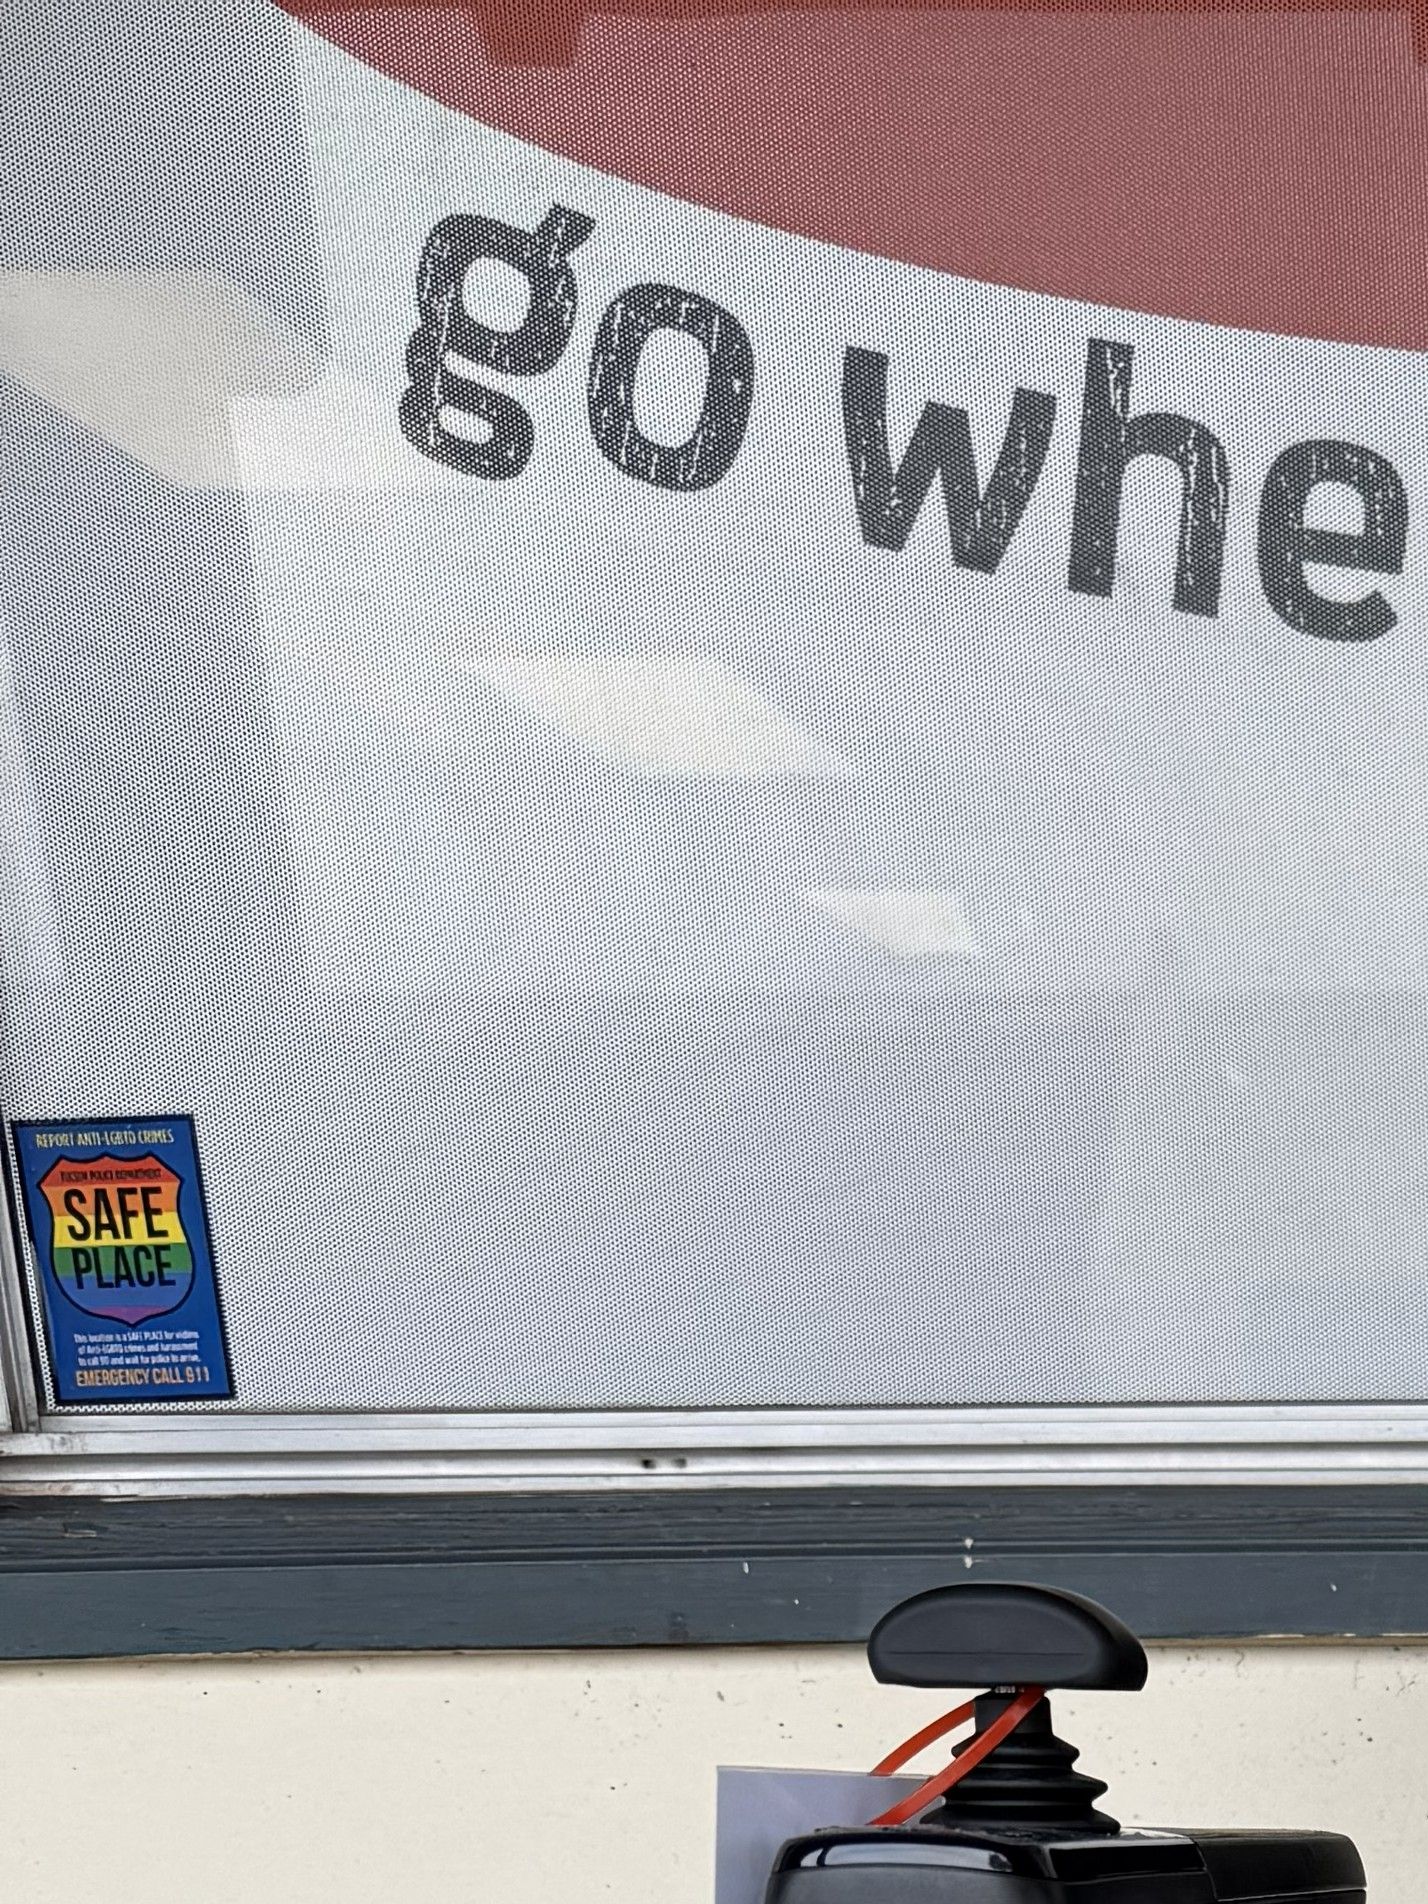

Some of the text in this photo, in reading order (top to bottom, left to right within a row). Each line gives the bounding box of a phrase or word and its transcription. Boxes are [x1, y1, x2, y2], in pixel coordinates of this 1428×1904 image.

[397, 203, 756, 492] go
[36, 1133, 74, 1149] REPORT
[138, 1128, 175, 1144] CRIMES
[63, 1186, 169, 1241] SAFE
[71, 1244, 176, 1290] PLACE
[76, 1368, 150, 1387] EMERGENCY
[152, 1367, 184, 1384] CALL
